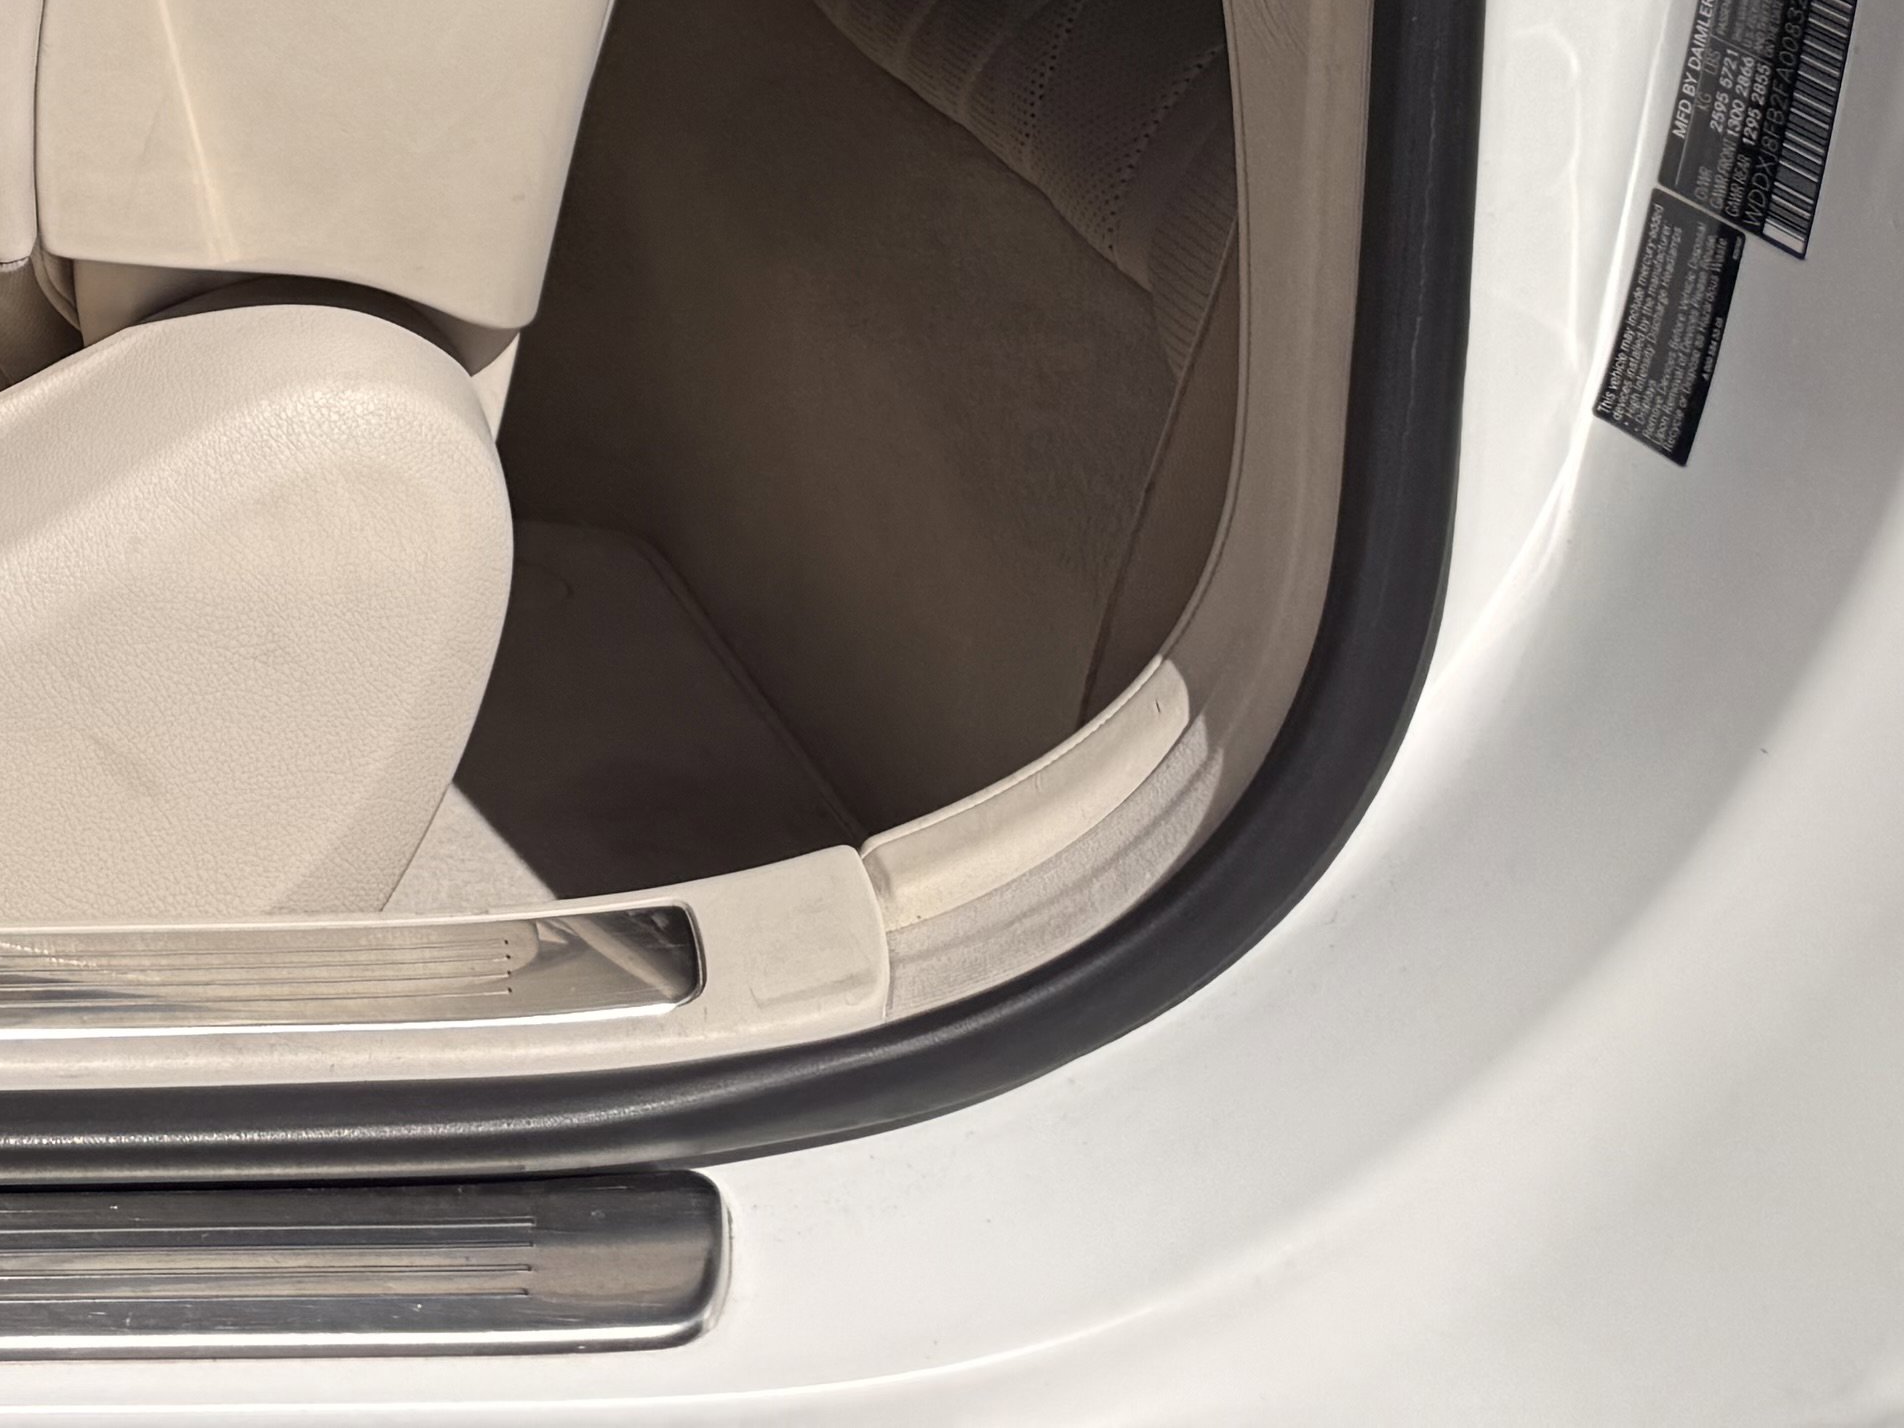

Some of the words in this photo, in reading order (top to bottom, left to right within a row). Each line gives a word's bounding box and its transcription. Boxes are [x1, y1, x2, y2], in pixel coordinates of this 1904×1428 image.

[1681, 70, 1699, 97] BY
[1672, 97, 1693, 139] MFD
[1708, 90, 1731, 134] 2595
[1725, 98, 1746, 138] 1300
[1625, 285, 1645, 327] include
[1636, 315, 1650, 333] by
[1640, 295, 1655, 316] the
[1619, 325, 1636, 352] may
[1605, 349, 1627, 390] vehicle
[1596, 389, 1615, 414] This
[1610, 378, 1633, 421] devices
